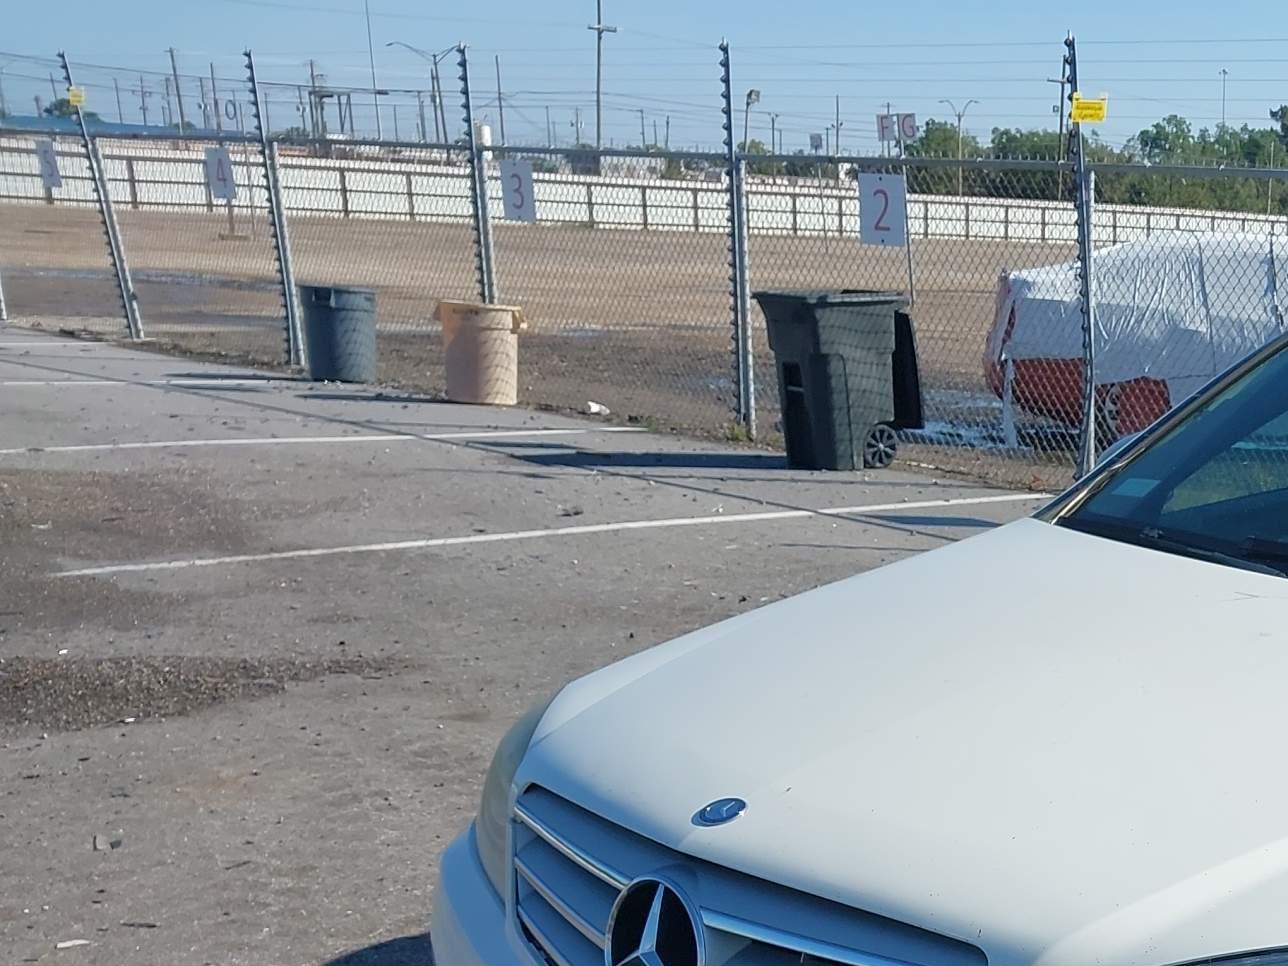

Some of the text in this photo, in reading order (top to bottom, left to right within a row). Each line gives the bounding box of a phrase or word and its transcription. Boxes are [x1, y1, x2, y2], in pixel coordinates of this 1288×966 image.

[216, 158, 227, 188] 4
[511, 173, 525, 209] 3
[873, 189, 891, 231] 2
